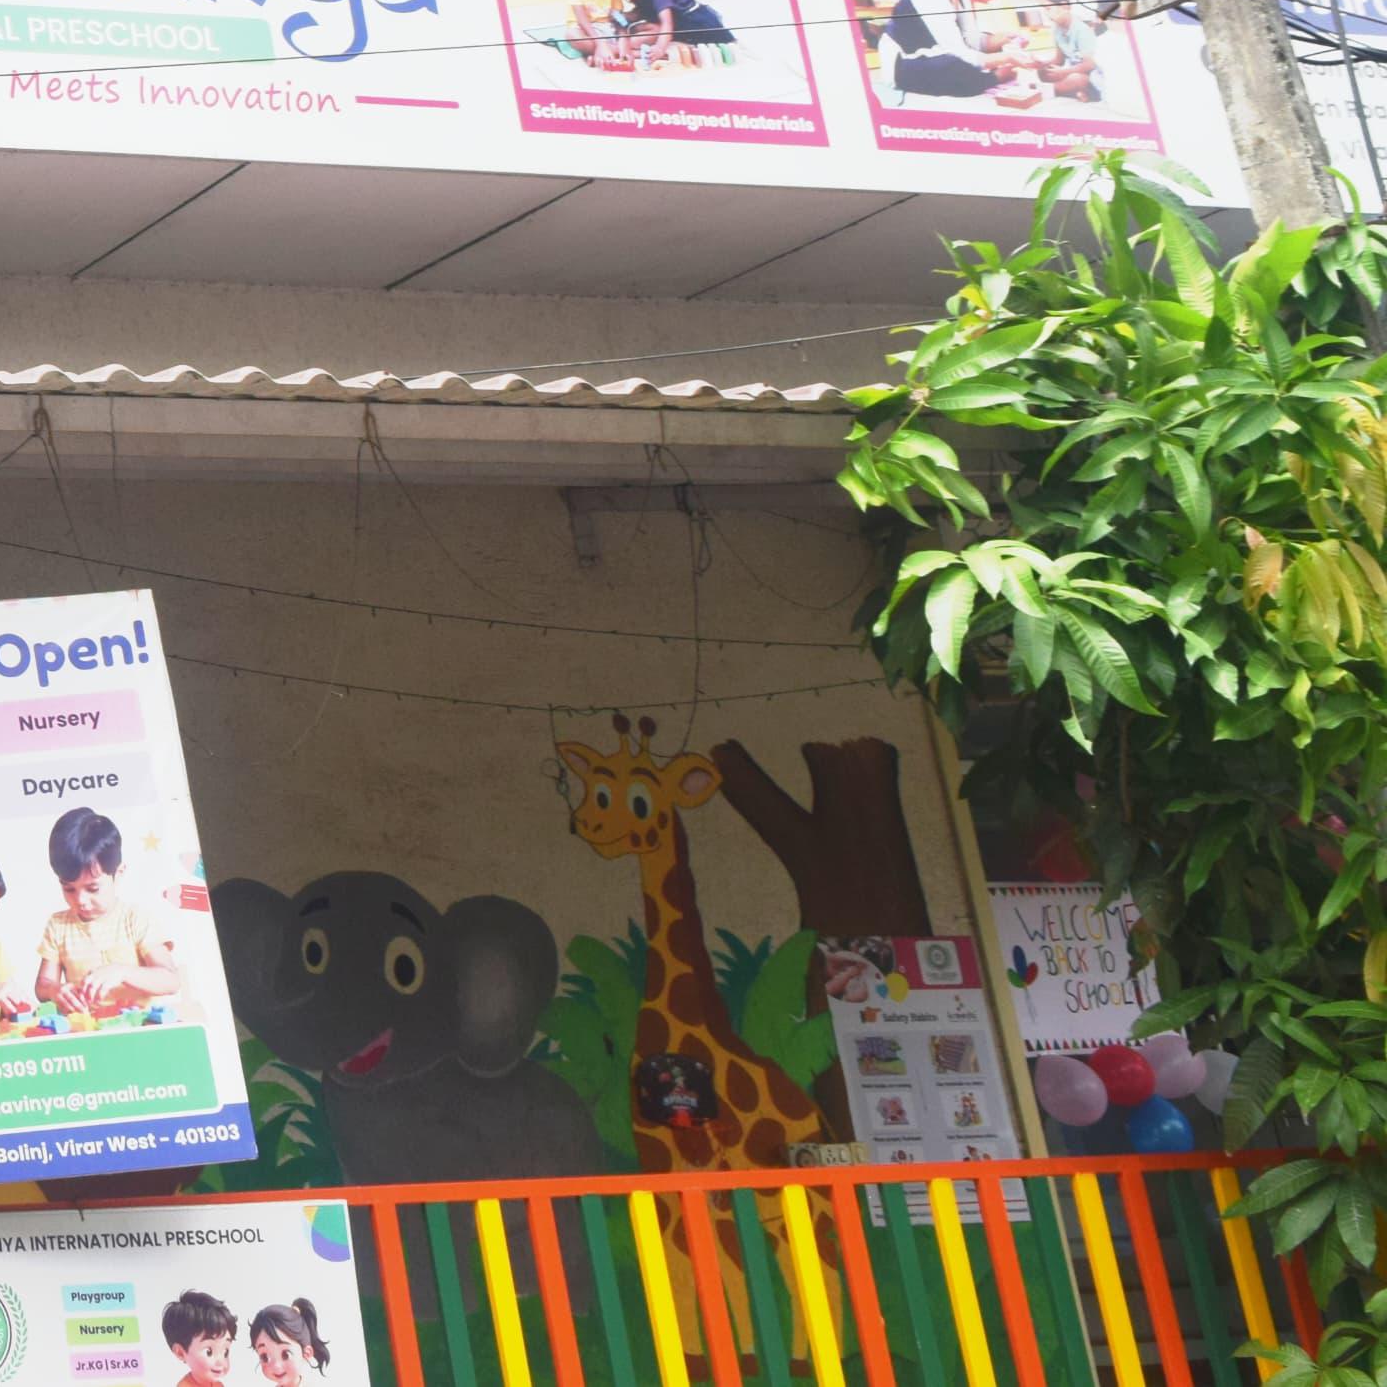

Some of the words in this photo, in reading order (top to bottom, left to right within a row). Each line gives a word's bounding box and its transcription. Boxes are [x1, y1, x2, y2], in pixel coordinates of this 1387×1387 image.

[29, 17, 221, 53] PRESCHOOL
[11, 70, 121, 105] Meets
[137, 74, 341, 115] Innovation
[530, 103, 646, 129] Scientifically
[648, 110, 730, 132] Designed
[733, 114, 815, 133] Materials
[19, 709, 101, 734] Nursery
[21, 771, 119, 798] Daycare
[1014, 902, 1136, 942] WELCOME
[1040, 945, 1089, 976] BACK
[1093, 944, 1116, 973] TO
[41, 1055, 86, 1075] 07111
[56, 1139, 104, 1158] Virar
[106, 1133, 156, 1154] West
[173, 1123, 241, 1145] 401303
[29, 1232, 162, 1252] INTERNATIONAL
[165, 1228, 265, 1246] PRESCHOOL
[71, 1291, 125, 1304] Playgroup
[79, 1324, 124, 1336] Nursery
